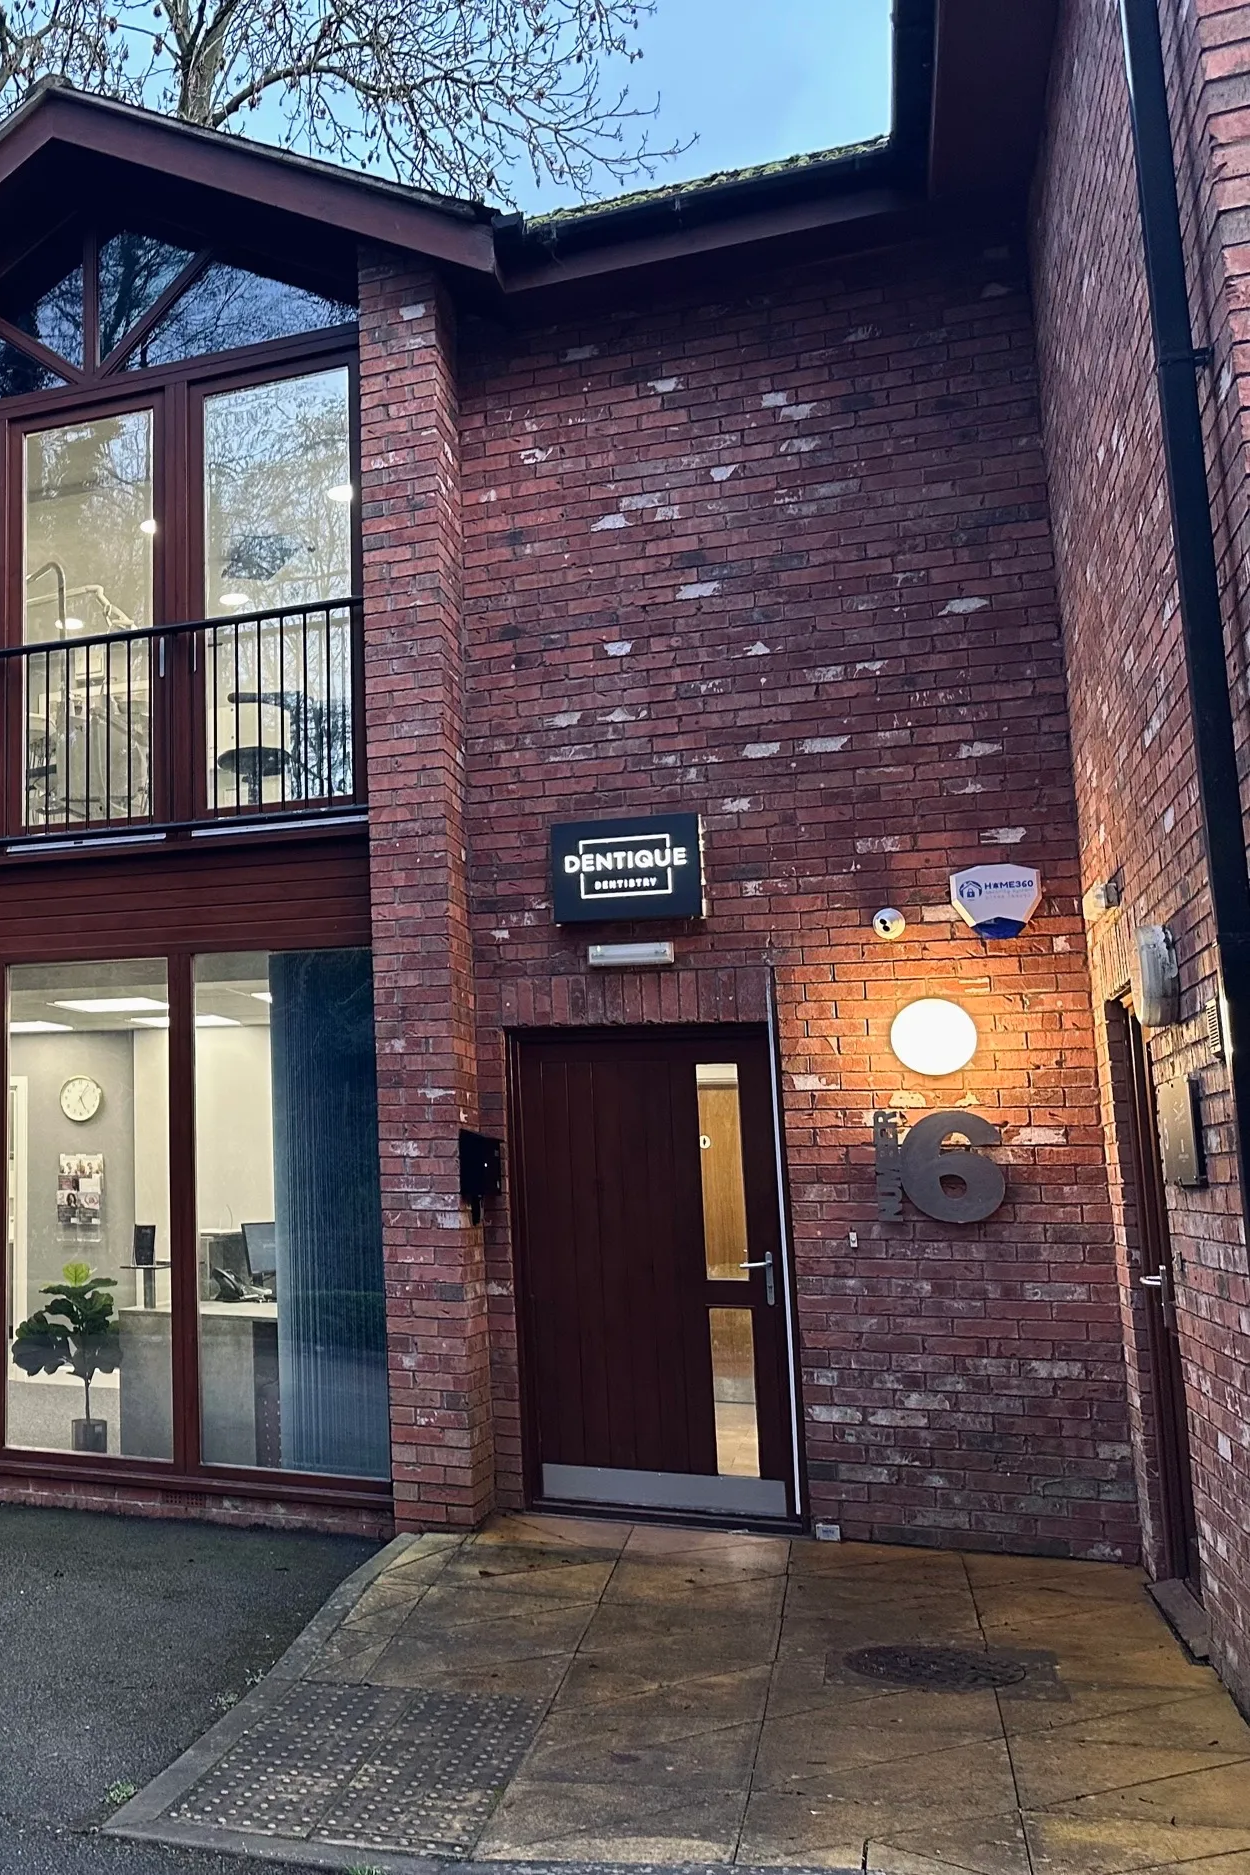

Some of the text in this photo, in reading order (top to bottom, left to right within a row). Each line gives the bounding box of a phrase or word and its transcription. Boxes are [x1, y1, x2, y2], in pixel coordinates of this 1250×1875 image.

[564, 847, 687, 873] DENTIQUE
[594, 877, 657, 890] DENTISTRY
[901, 1110, 1006, 1223] 6
